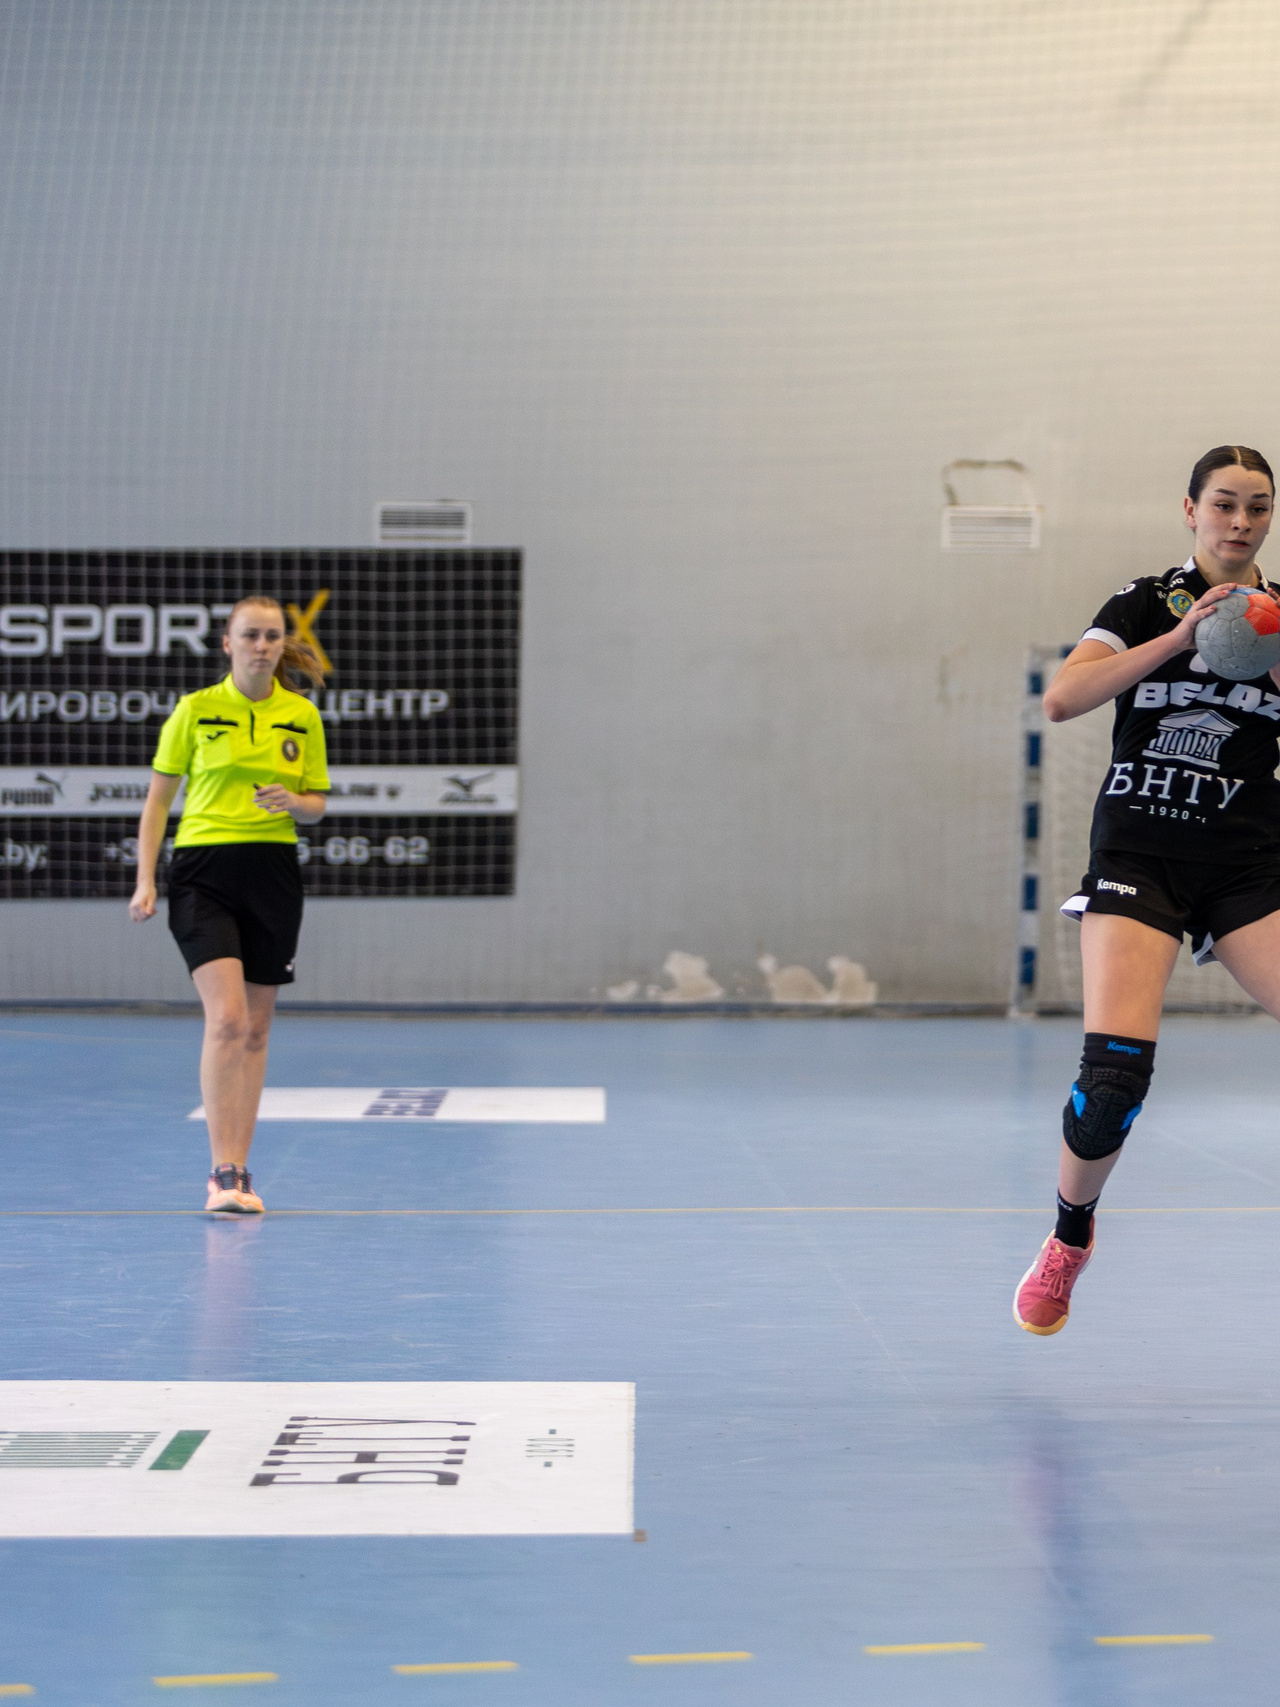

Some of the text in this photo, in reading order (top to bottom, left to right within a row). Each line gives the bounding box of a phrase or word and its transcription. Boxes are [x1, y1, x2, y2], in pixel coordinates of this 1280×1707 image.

[315, 689, 450, 723] ЦЕНТР
[1105, 762, 1245, 810] БНТУ
[1148, 804, 1190, 821] 1920
[1096, 878, 1138, 896] Kempa
[1106, 1040, 1142, 1056] Kempa
[249, 1415, 477, 1487] БНТУ
